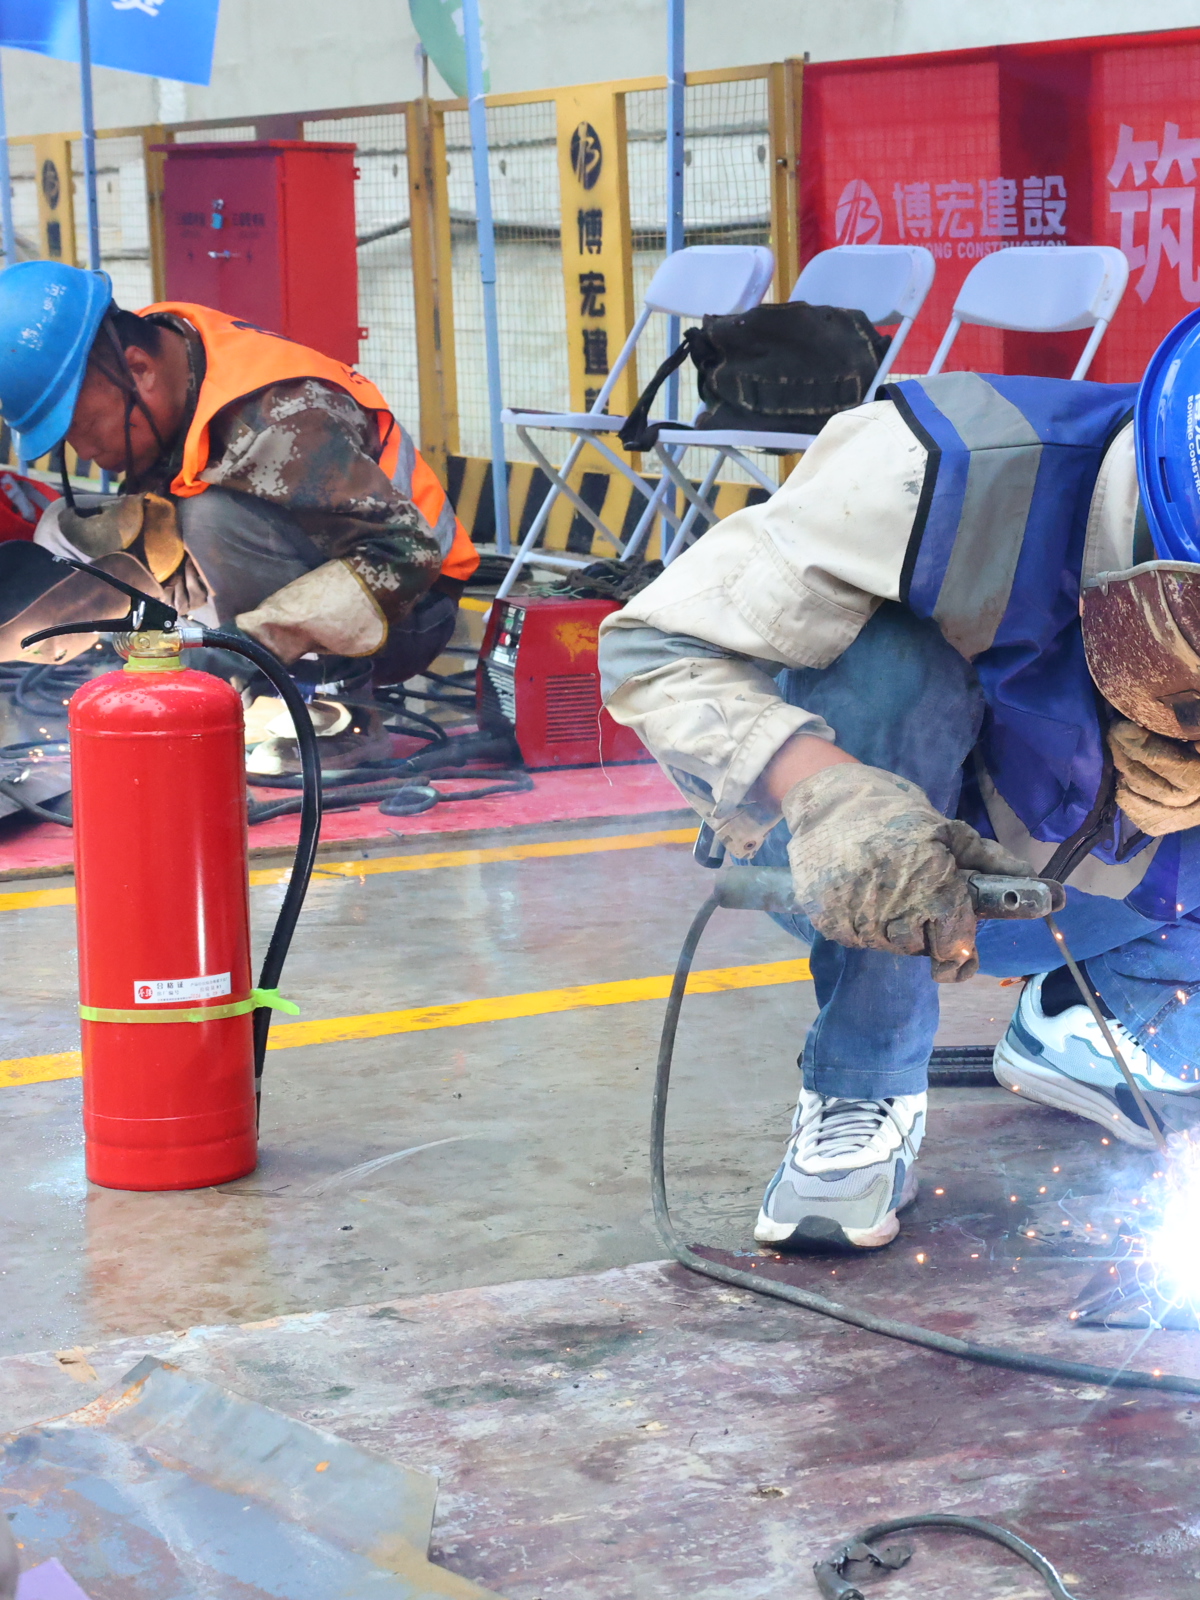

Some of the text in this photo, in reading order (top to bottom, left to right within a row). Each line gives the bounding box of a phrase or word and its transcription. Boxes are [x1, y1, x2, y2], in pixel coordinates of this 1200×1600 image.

[893, 175, 1068, 239] 博宏建設
[1187, 395, 1195, 441] BOHONG
